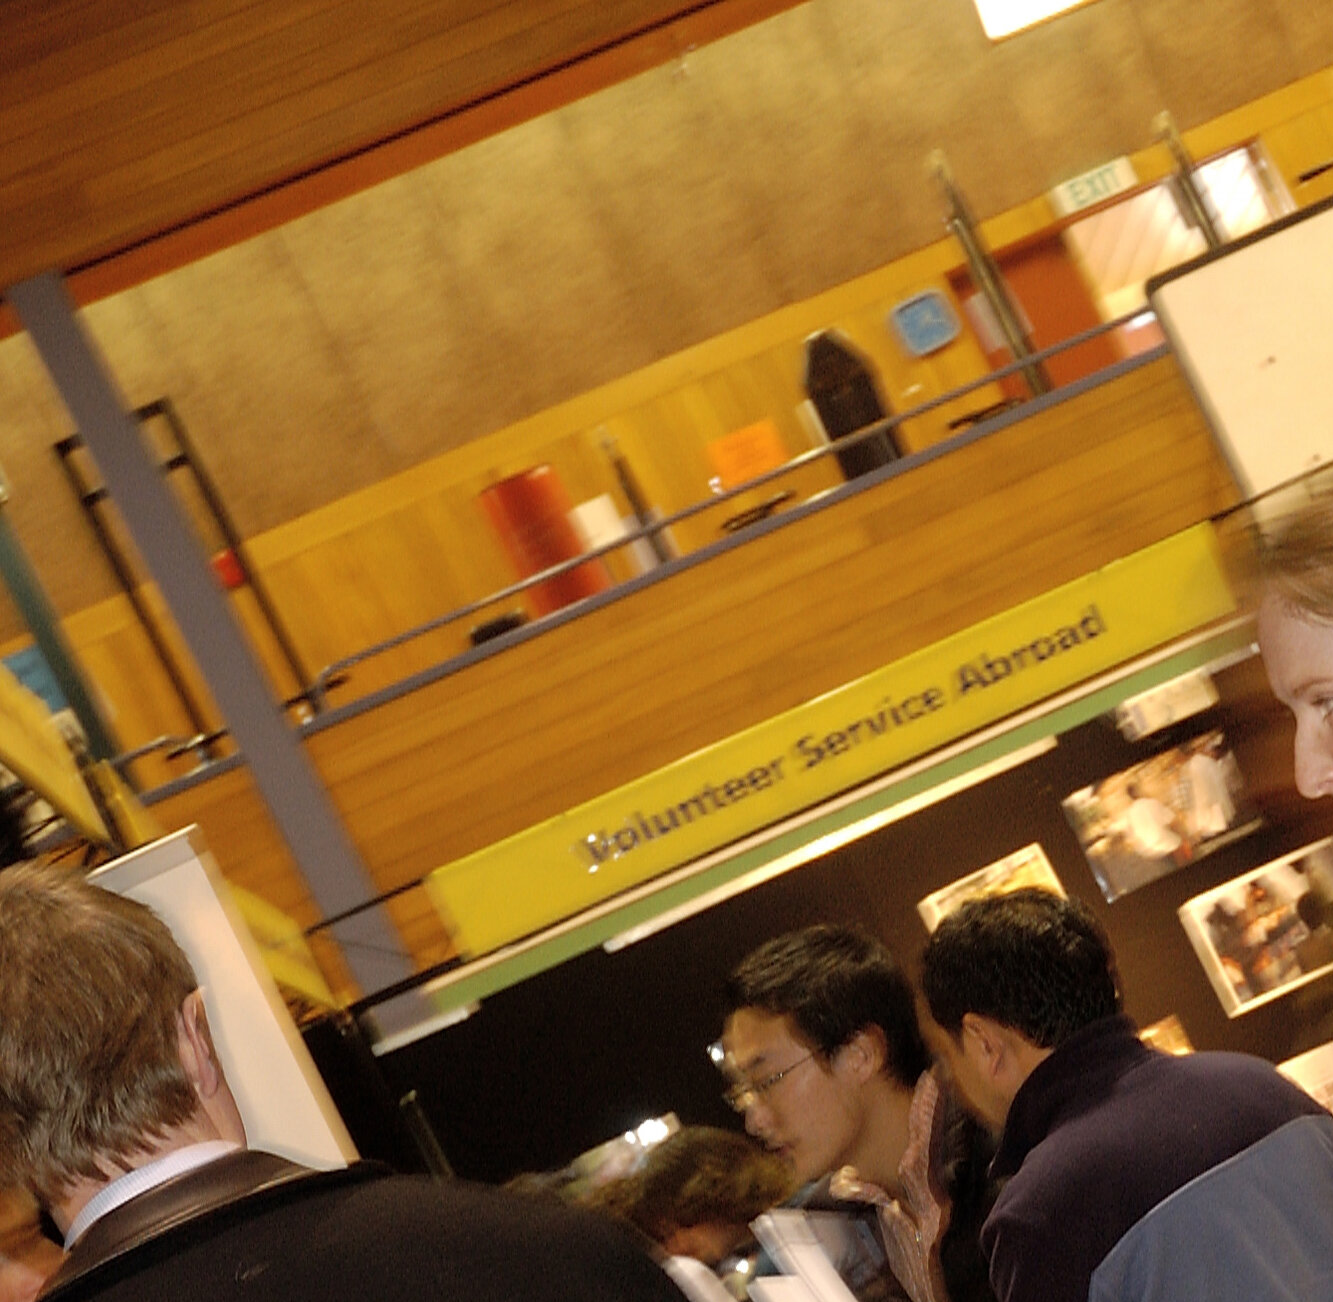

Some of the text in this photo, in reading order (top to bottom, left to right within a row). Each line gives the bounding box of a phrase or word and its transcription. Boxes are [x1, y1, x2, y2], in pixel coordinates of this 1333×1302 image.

[1067, 165, 1121, 207] EXIT
[576, 604, 1109, 868] Volunteer Service Abroad
